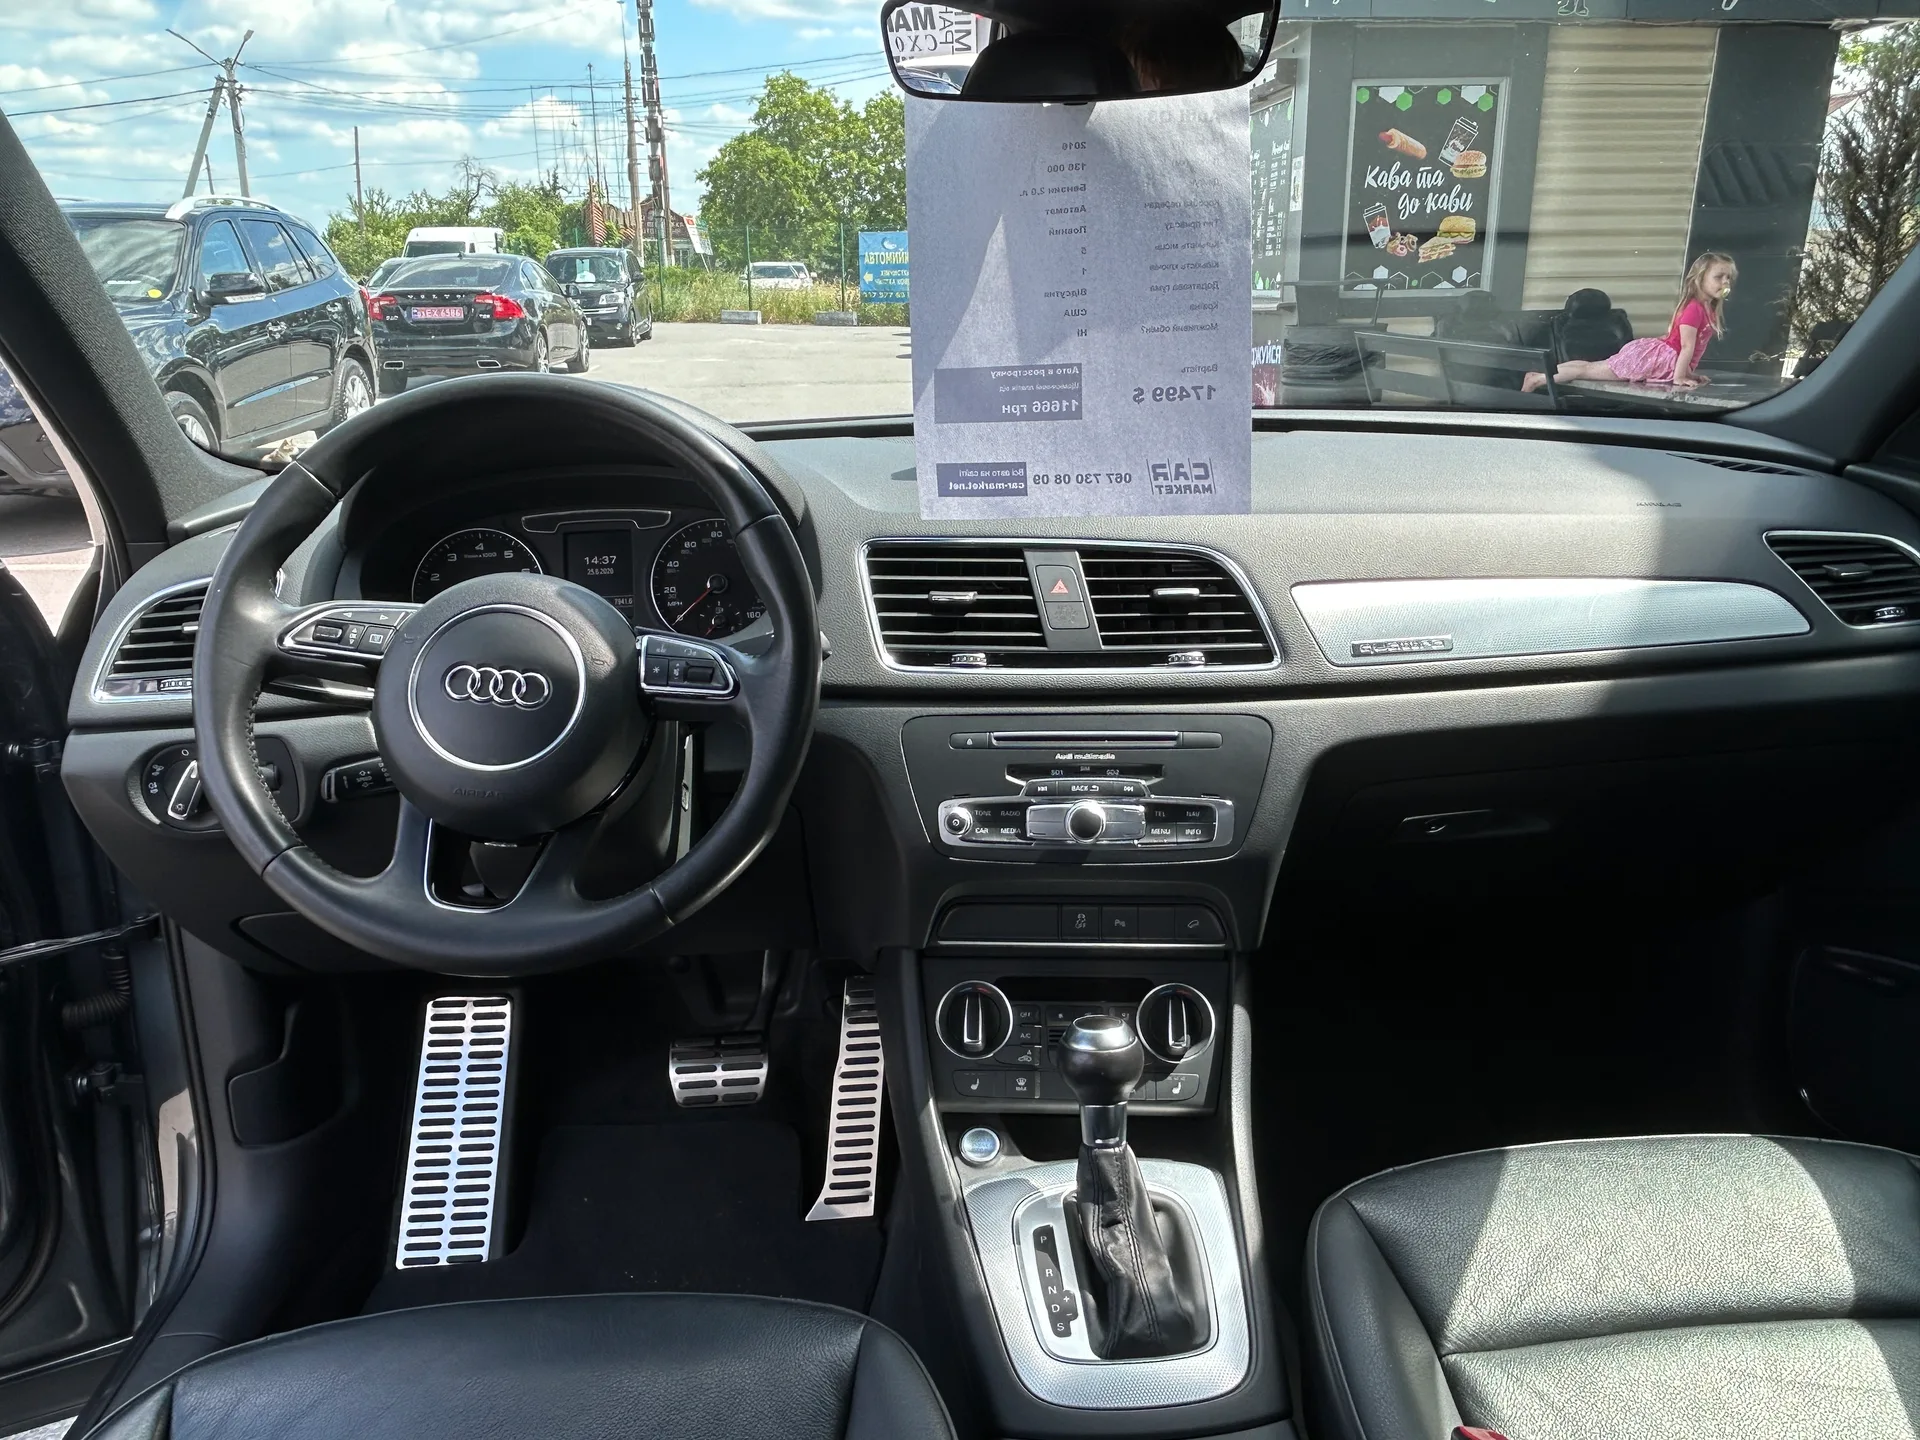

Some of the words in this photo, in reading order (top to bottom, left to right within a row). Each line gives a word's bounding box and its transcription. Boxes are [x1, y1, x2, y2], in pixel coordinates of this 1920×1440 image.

[1365, 161, 1413, 191] Кава
[1416, 166, 1445, 189] та
[1398, 191, 1421, 220] до
[1424, 183, 1474, 212] кави
[474, 542, 485, 551] 4
[684, 541, 697, 549] 60
[447, 553, 458, 562] 3
[503, 550, 514, 559] 5
[584, 555, 617, 565] 14:37
[666, 560, 680, 568] 40
[430, 573, 441, 581] 2
[663, 586, 677, 594] 20
[974, 809, 992, 817] TONE
[1040, 1235, 1048, 1244] P
[1045, 1268, 1054, 1277] R
[1048, 1286, 1058, 1295] N
[1051, 1304, 1060, 1313] D
[1057, 1322, 1065, 1331] S
